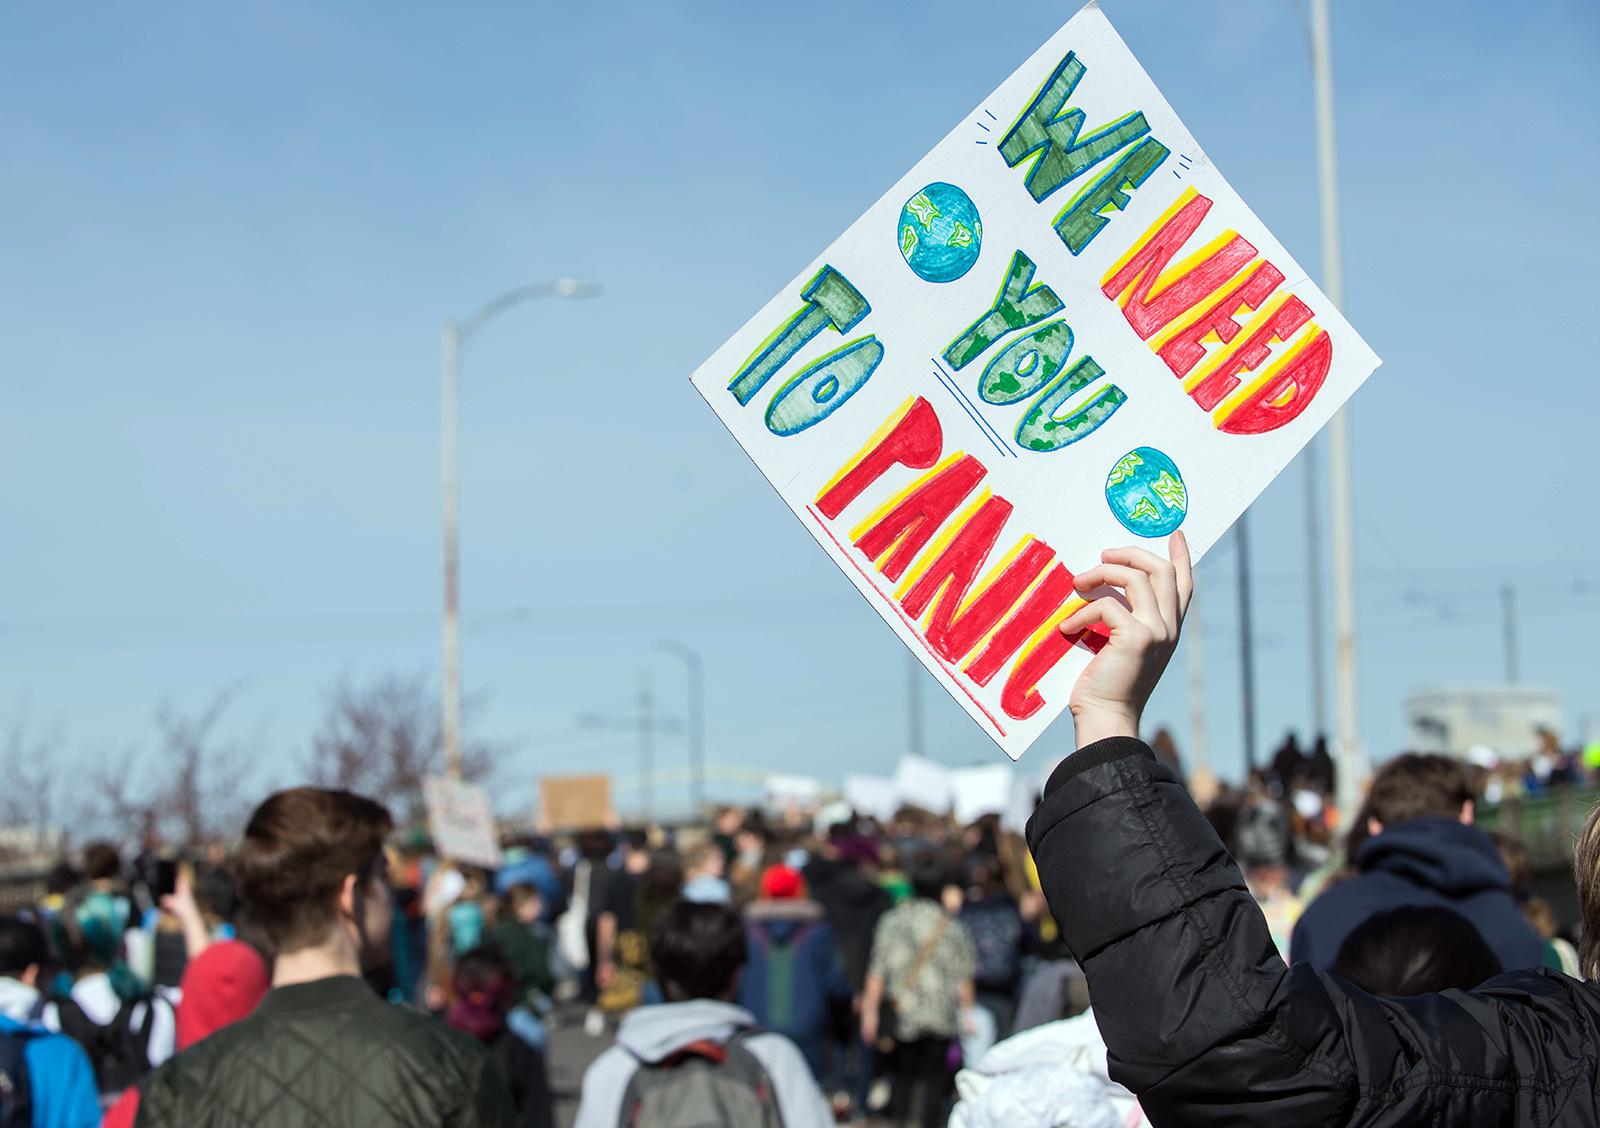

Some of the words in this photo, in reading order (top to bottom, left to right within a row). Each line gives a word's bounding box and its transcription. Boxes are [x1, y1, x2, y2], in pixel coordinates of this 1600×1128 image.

[941, 249, 1128, 452] YOU
[998, 50, 1171, 256] WE
[1101, 185, 1333, 435] NEED
[728, 263, 884, 437] TO
[814, 394, 1111, 720] PANIC
